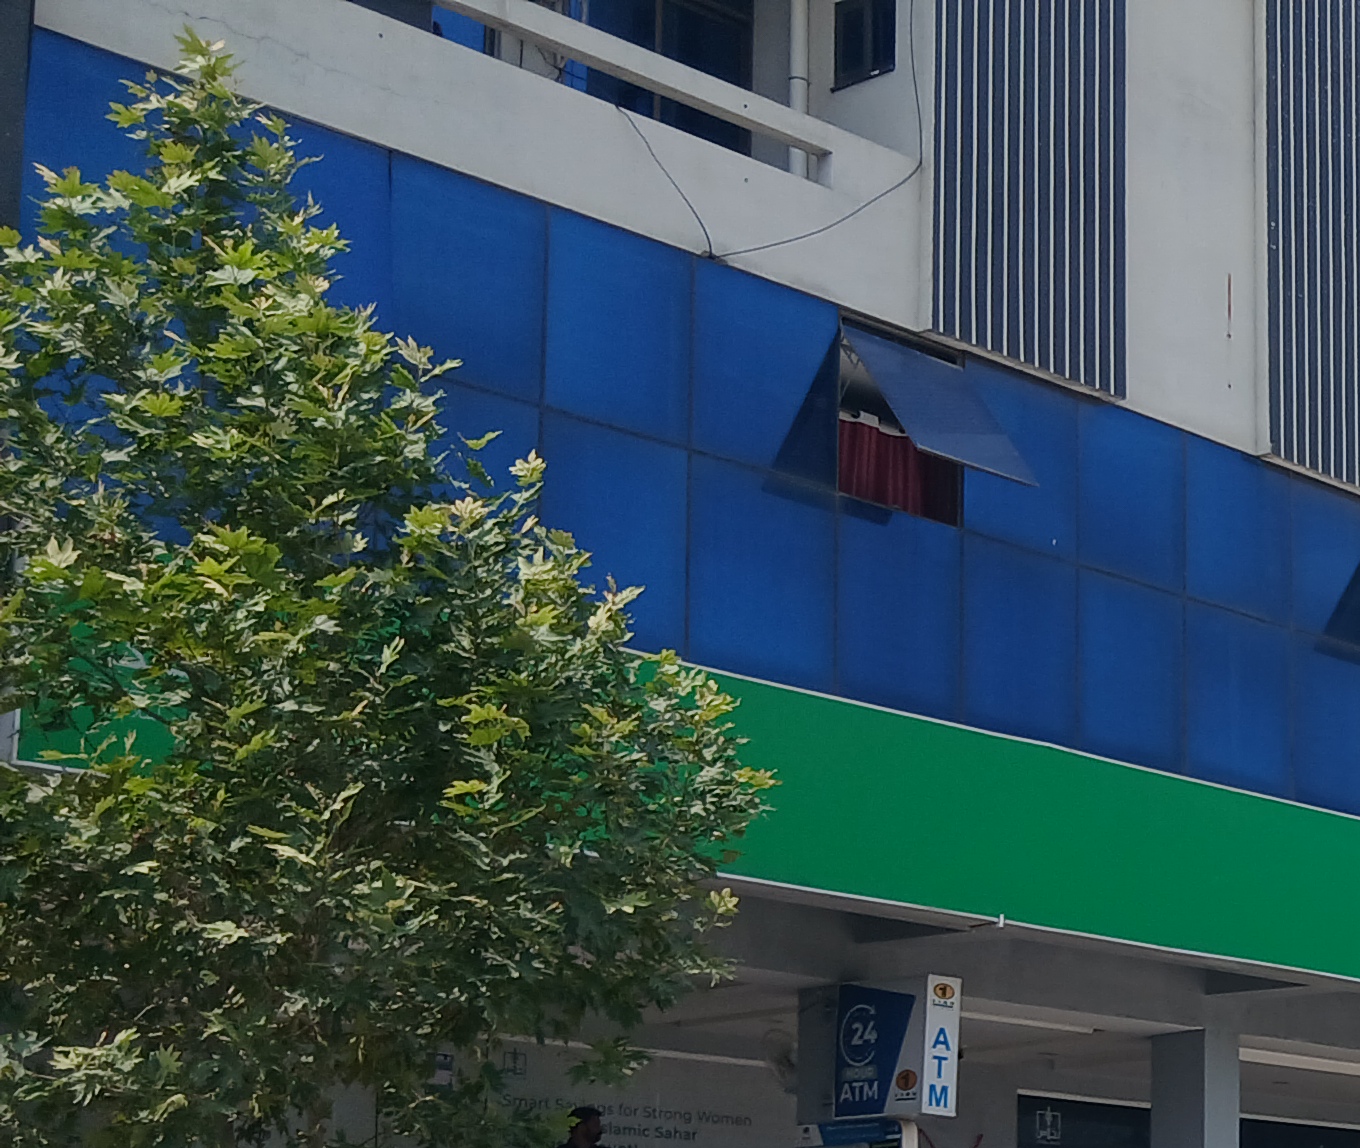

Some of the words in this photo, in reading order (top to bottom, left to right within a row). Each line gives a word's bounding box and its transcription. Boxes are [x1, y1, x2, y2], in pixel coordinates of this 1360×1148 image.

[850, 1021, 878, 1046] 24
[928, 1027, 952, 1108] ATM
[839, 1080, 879, 1103] ATM
[502, 1093, 549, 1111] Smart
[618, 1103, 639, 1117] for
[642, 1106, 692, 1124] Strong
[697, 1110, 752, 1127] Women
[601, 1124, 650, 1139] slamic
[654, 1126, 698, 1142] Sahar
